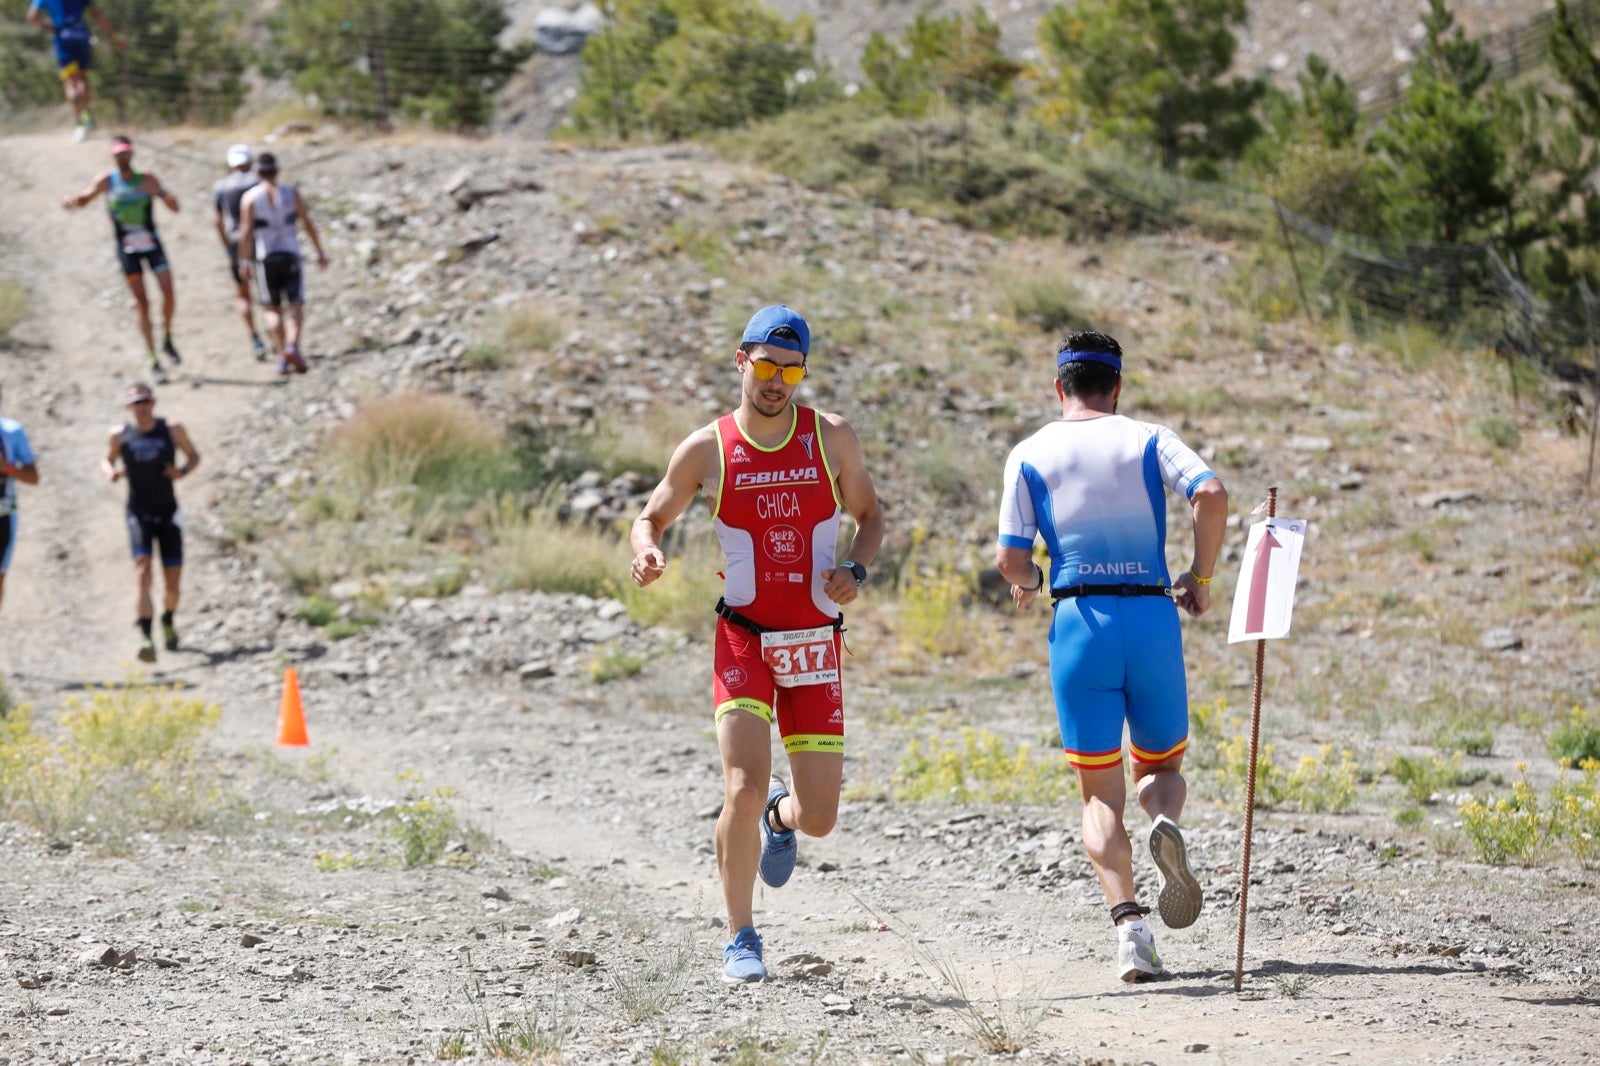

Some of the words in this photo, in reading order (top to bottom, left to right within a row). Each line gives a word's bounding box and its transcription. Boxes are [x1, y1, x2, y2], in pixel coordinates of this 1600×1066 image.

[735, 467, 818, 486] ISBILYA
[756, 492, 801, 519] CHICA
[1078, 562, 1149, 575] DANIEL
[773, 644, 827, 674] 317
